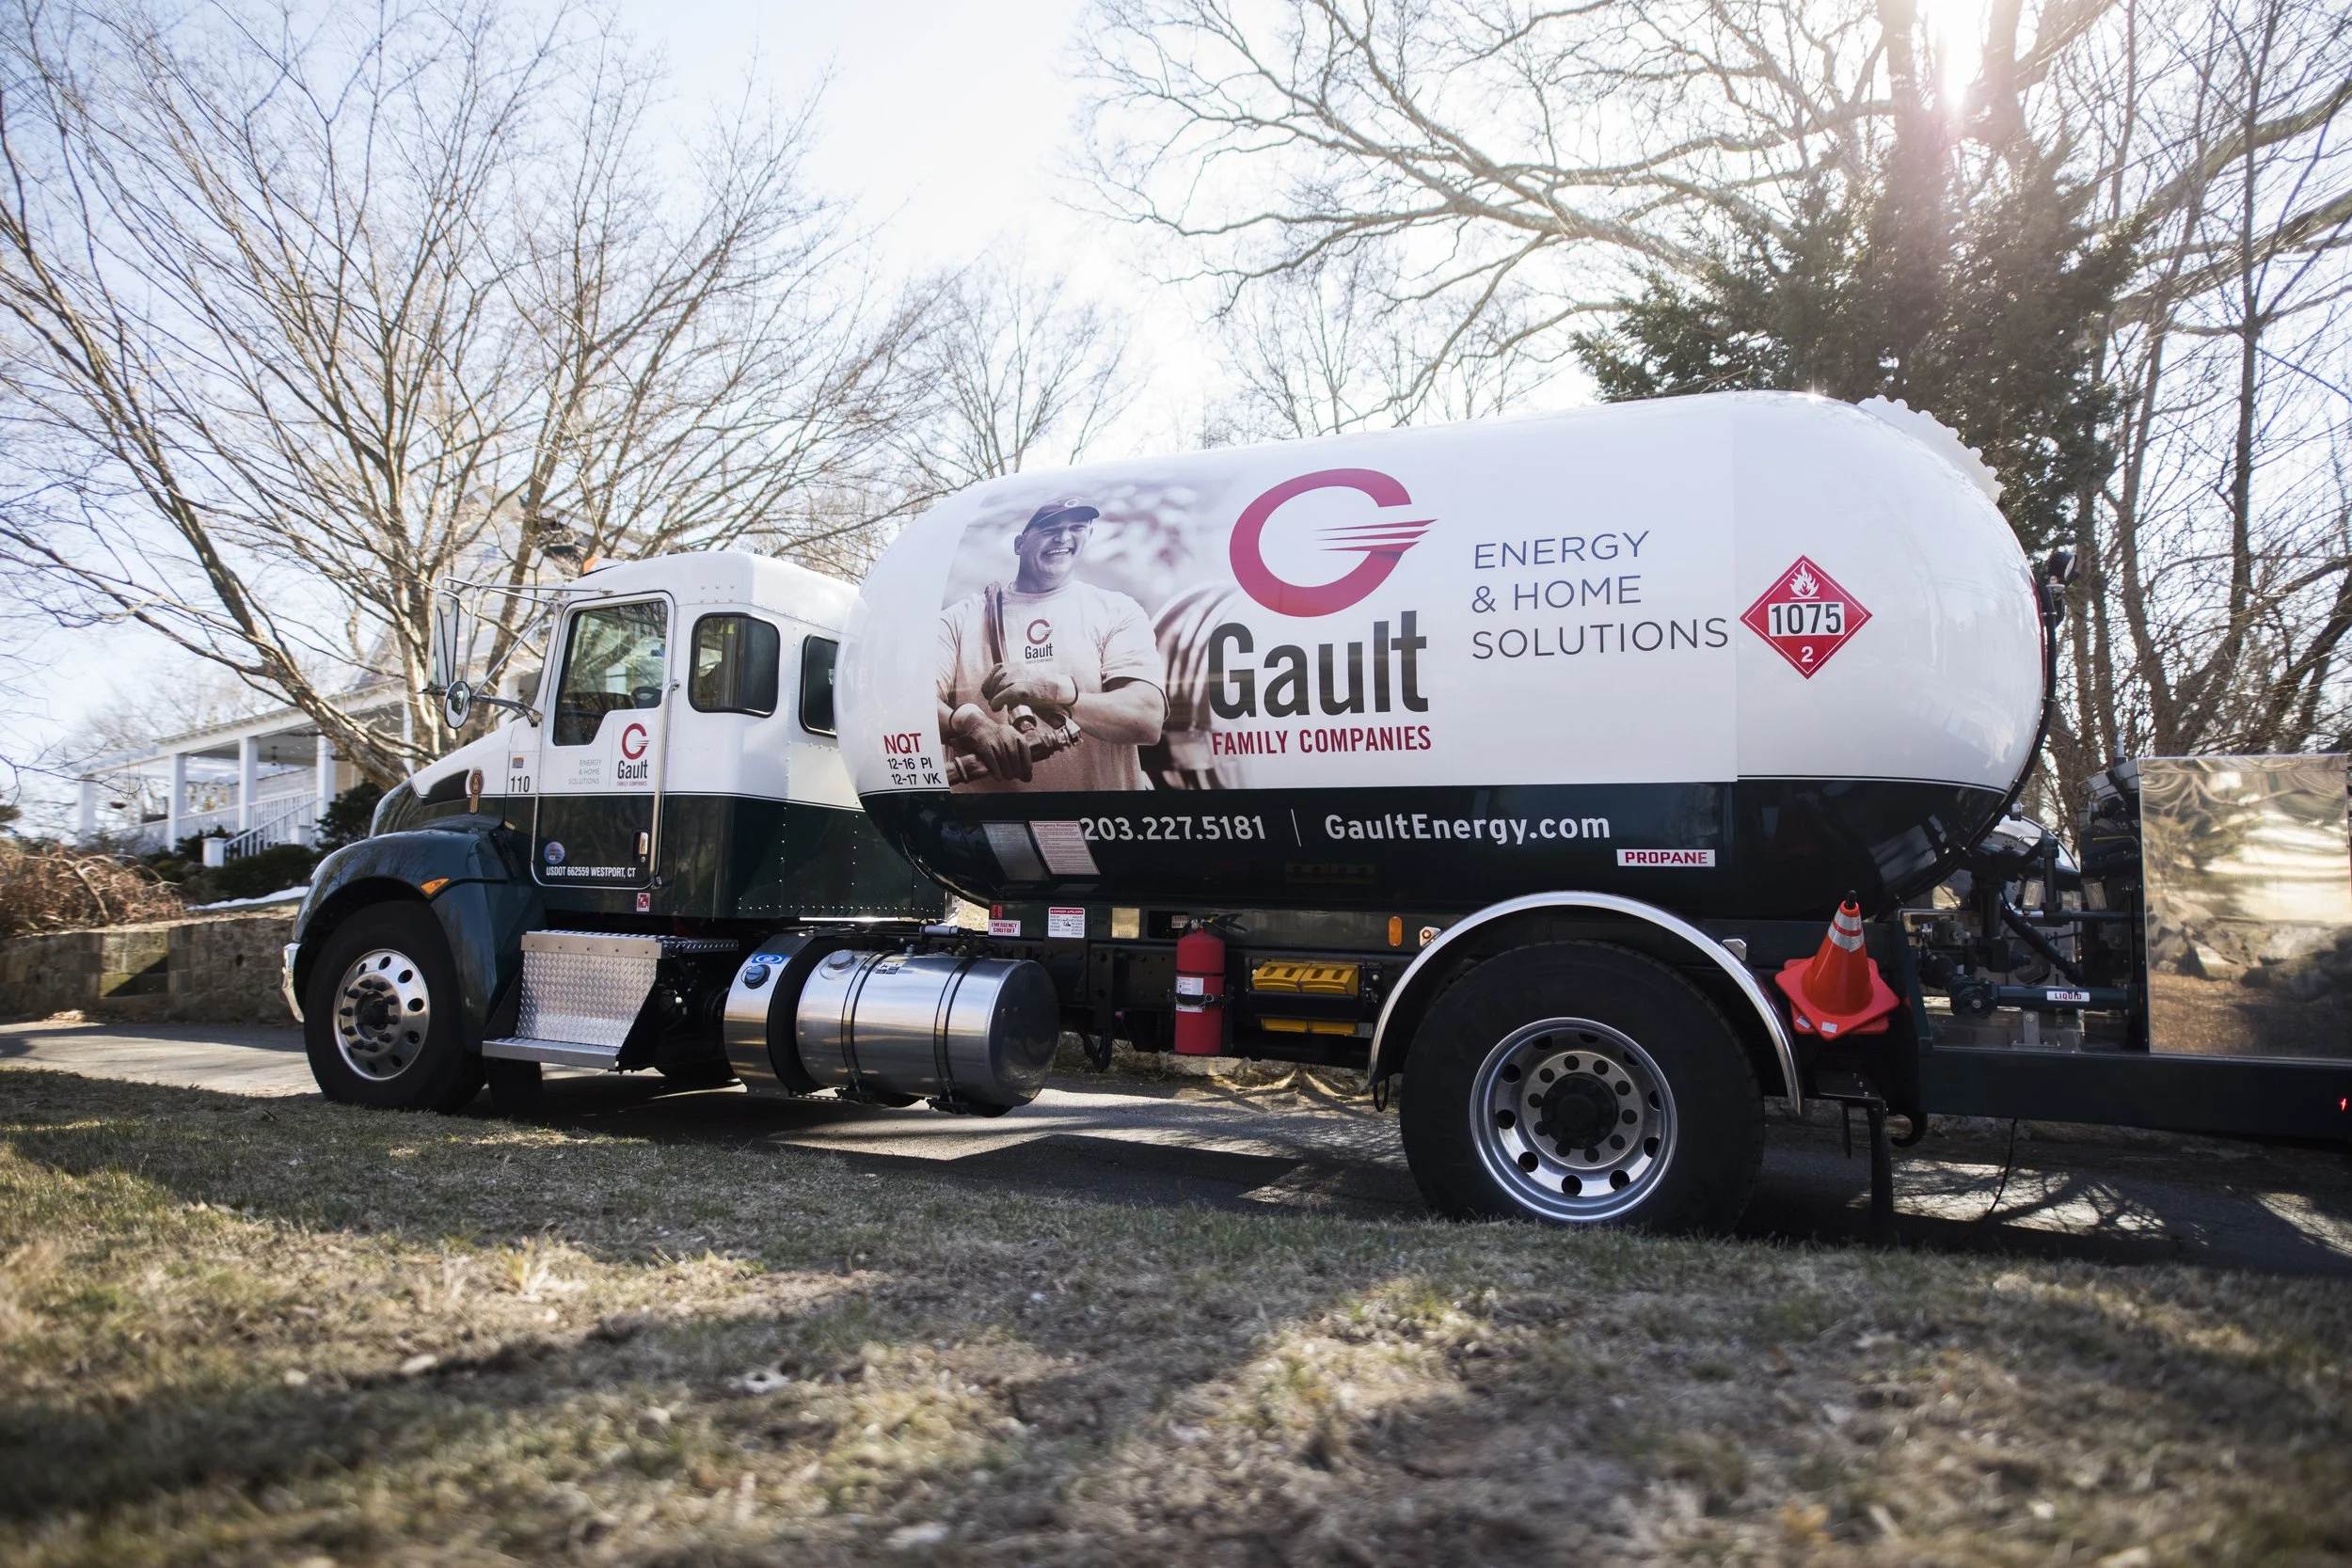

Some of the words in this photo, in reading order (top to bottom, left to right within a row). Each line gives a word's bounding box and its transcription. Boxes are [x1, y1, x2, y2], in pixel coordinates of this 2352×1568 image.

[1475, 531, 1649, 569] ENERGY
[1471, 586, 1496, 613] &
[1514, 575, 1641, 610] HOME
[1772, 603, 1841, 635] 1075
[1472, 617, 1728, 659] SOLUTIONS
[1025, 642, 1053, 659] Gault
[1801, 645, 1814, 662] 2
[1208, 610, 1429, 720] Gault
[883, 733, 921, 754] NQT
[1212, 730, 1288, 755] FAMILY
[1299, 725, 1431, 752] COMPANIES
[617, 759, 648, 779] Gault
[887, 757, 915, 769] 12-16
[920, 757, 932, 768] PI
[511, 775, 531, 792] 110
[568, 777, 600, 785] SOLUTIONS
[891, 773, 916, 785] 12-17
[923, 772, 942, 784] VK
[1080, 816, 1265, 841] 203.227.5181
[1325, 814, 1611, 845] GaultEnergy.com
[1625, 851, 1708, 863] PROPANE
[546, 866, 565, 877] USDOT
[567, 866, 589, 877] 662559
[590, 867, 626, 879] WESTPORT,
[628, 867, 636, 878] CT
[2055, 991, 2082, 1000] LIQUID
